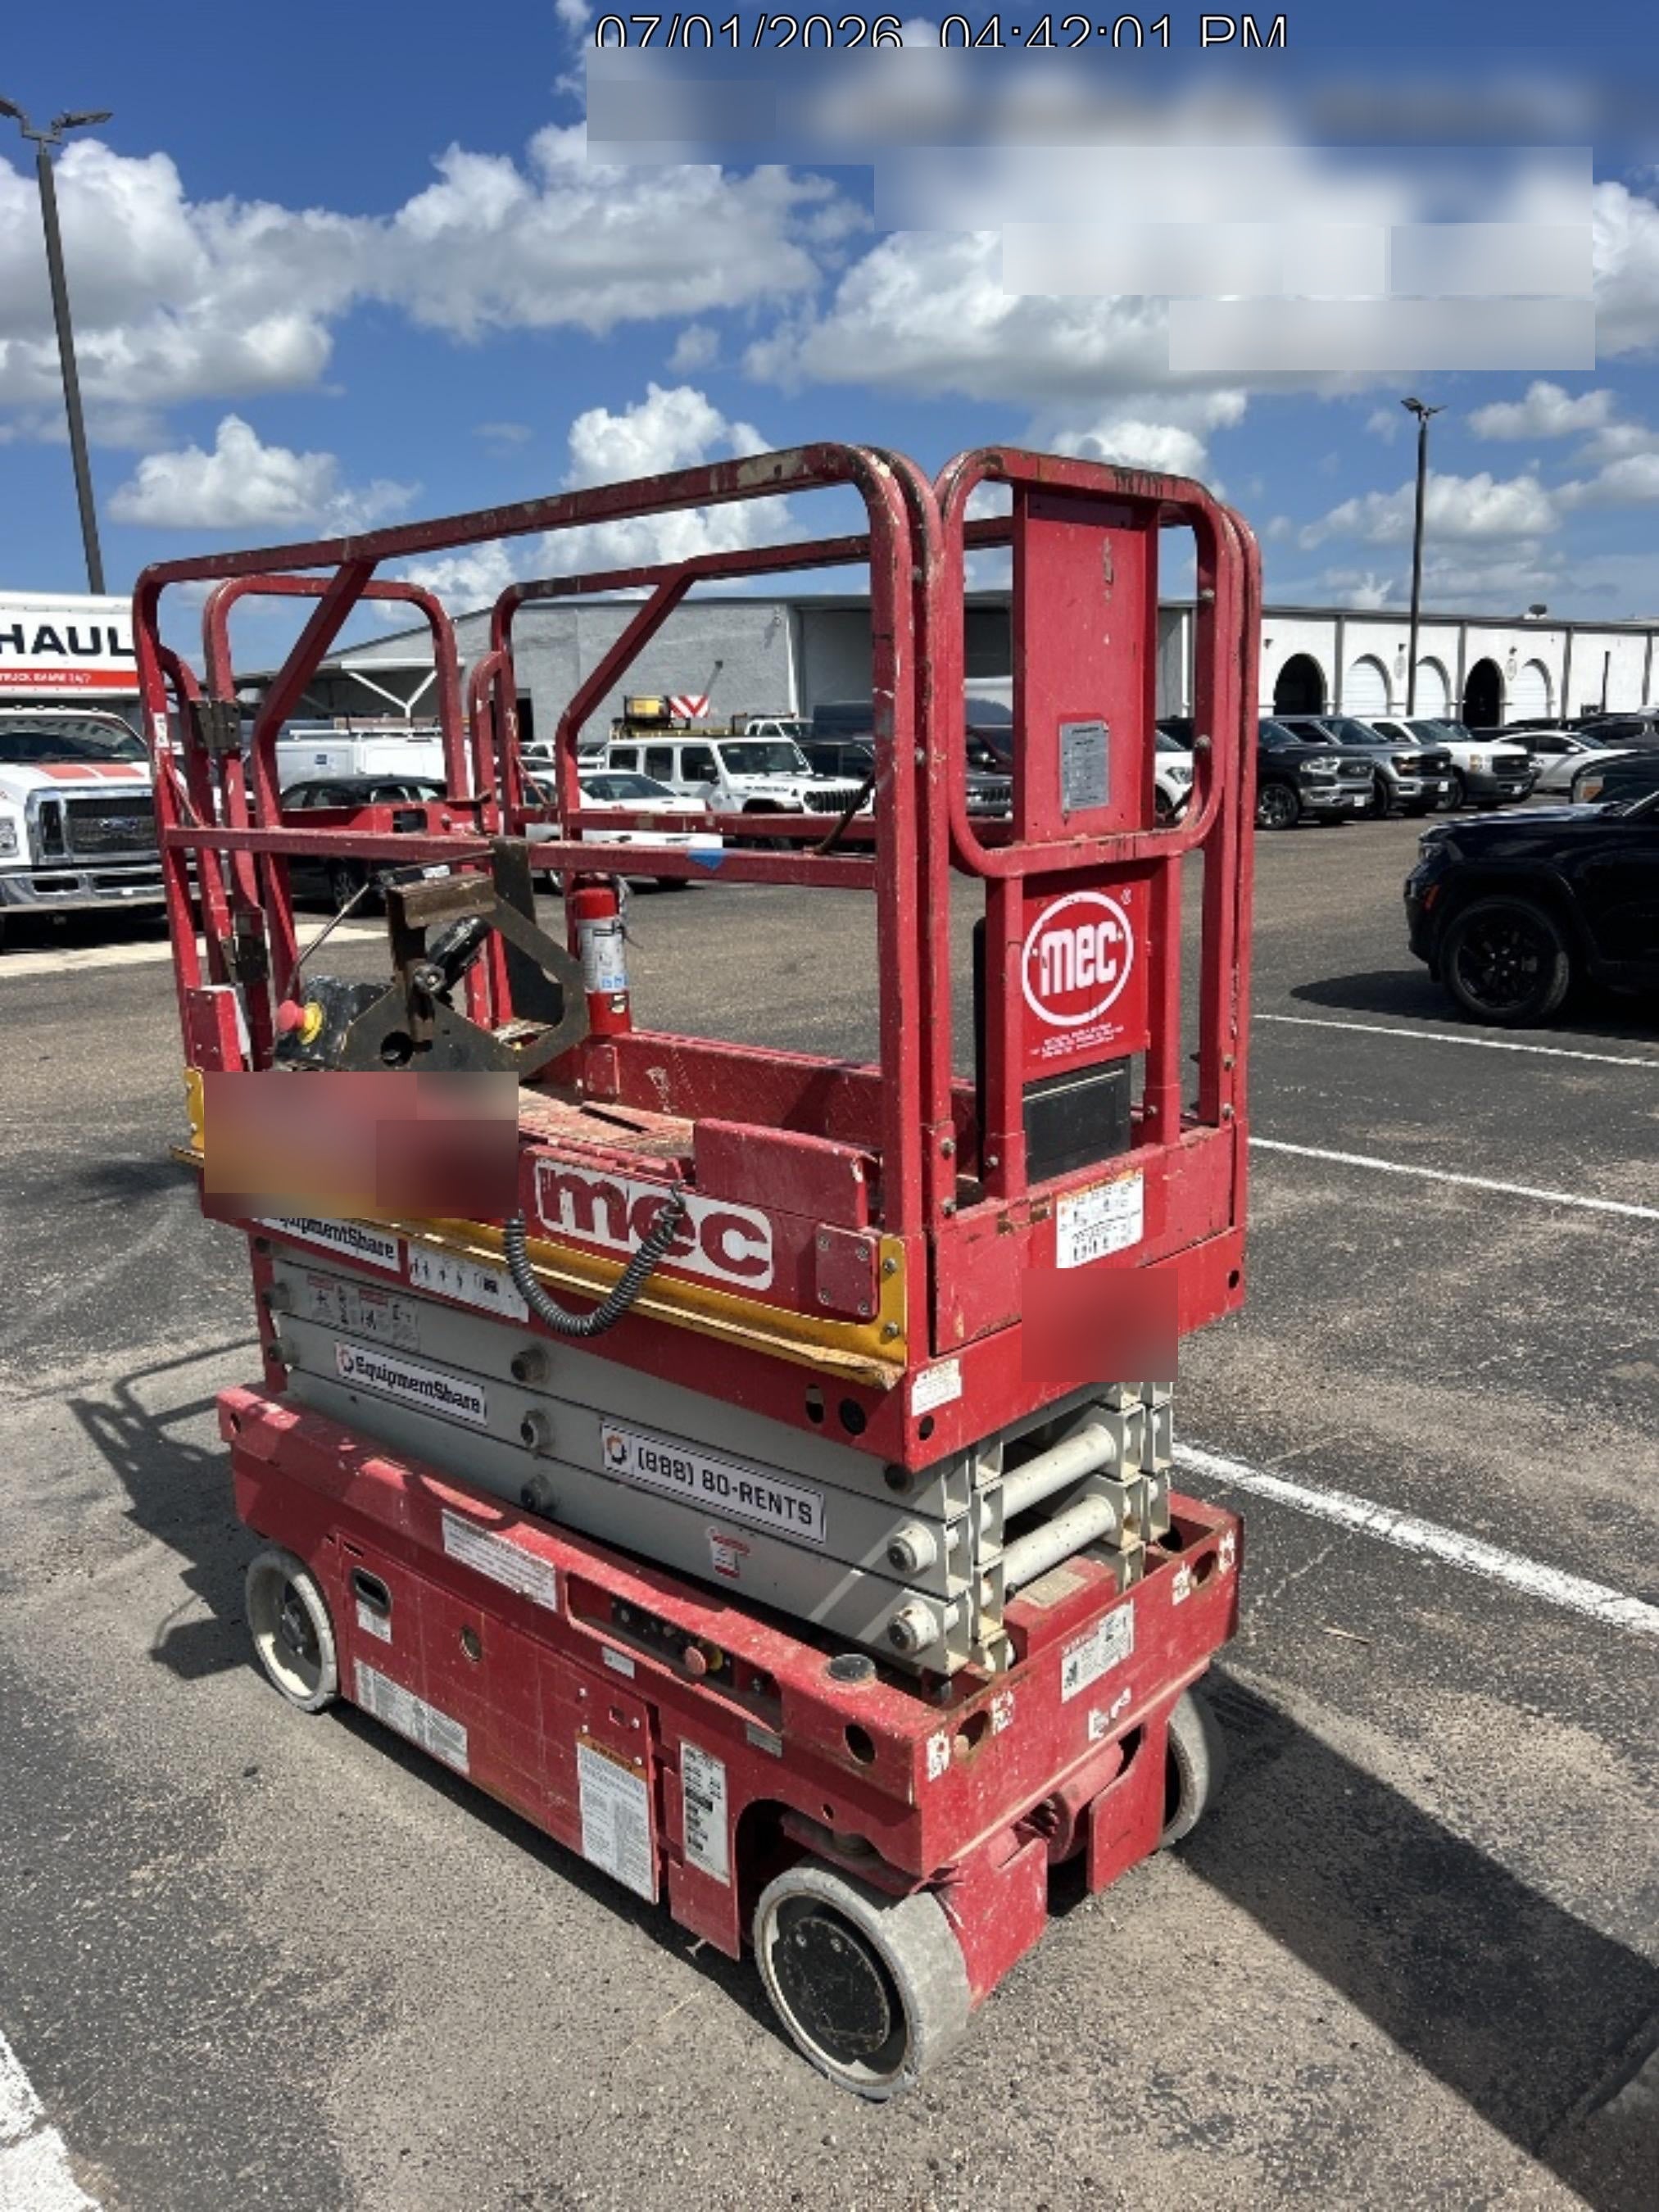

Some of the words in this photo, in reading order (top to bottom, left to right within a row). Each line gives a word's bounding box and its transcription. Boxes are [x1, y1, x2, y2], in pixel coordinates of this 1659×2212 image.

[0, 623, 136, 656] HAUL
[270, 1218, 395, 1259] uipmentShare
[356, 1354, 481, 1415] EquipmentShare
[637, 1447, 695, 1487] (888)
[701, 1469, 814, 1525] 80-RENTS
